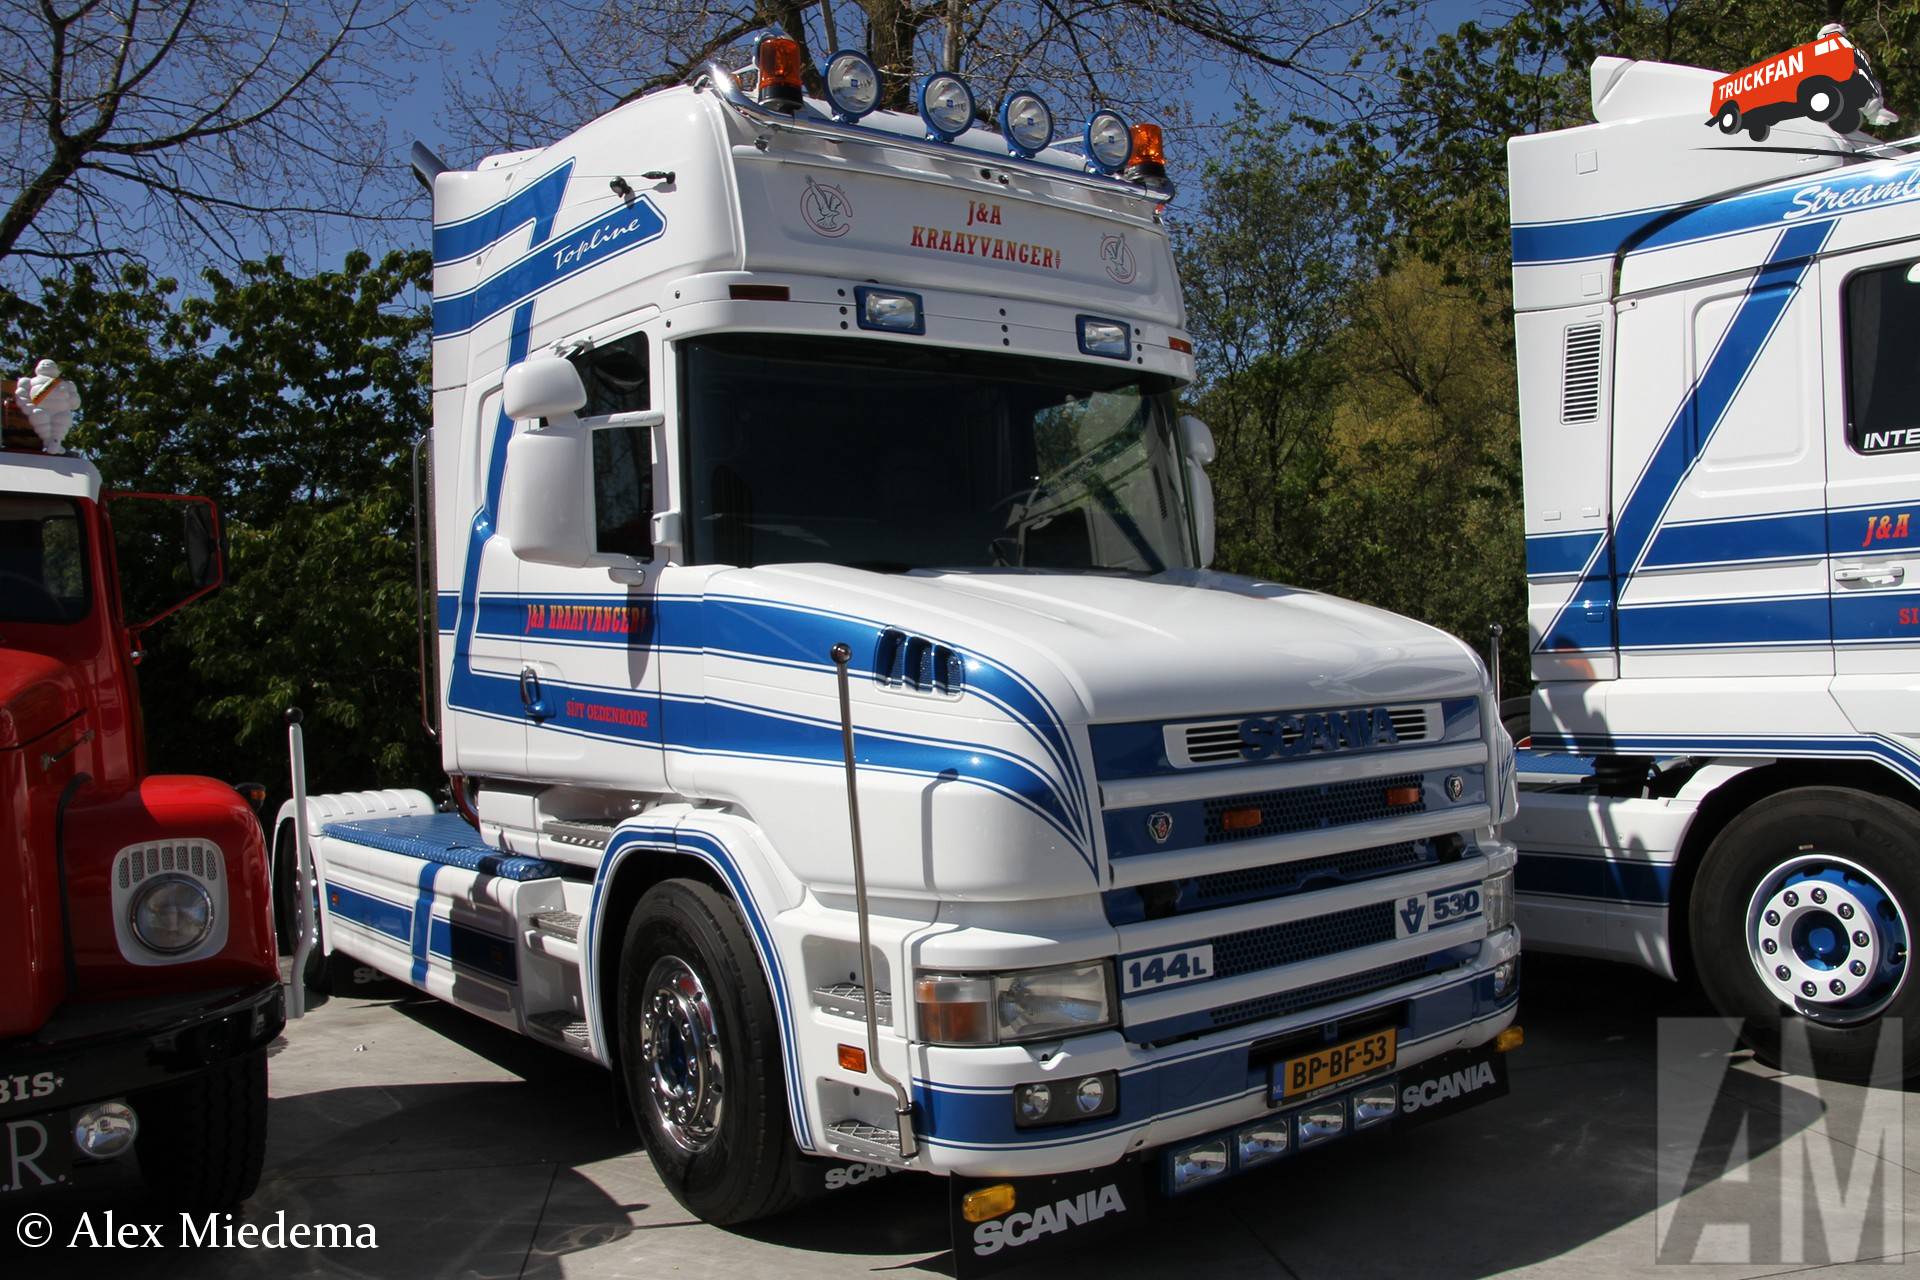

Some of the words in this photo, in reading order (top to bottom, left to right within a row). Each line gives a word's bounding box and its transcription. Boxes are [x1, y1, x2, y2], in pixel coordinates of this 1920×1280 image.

[967, 201, 1002, 226] J&A
[1783, 168, 1920, 219] Streaml
[553, 219, 640, 270] Topline
[910, 226, 1055, 268] KRAAYVANGER
[1863, 428, 1920, 449] INTE
[1862, 513, 1910, 547] J&A
[1238, 708, 1398, 760] SCANIA
[1434, 889, 1480, 919] 530
[1293, 1036, 1387, 1089] BP-BF-53
[1402, 1061, 1496, 1113] SCANIA
[973, 1184, 1127, 1256] SCANIA
